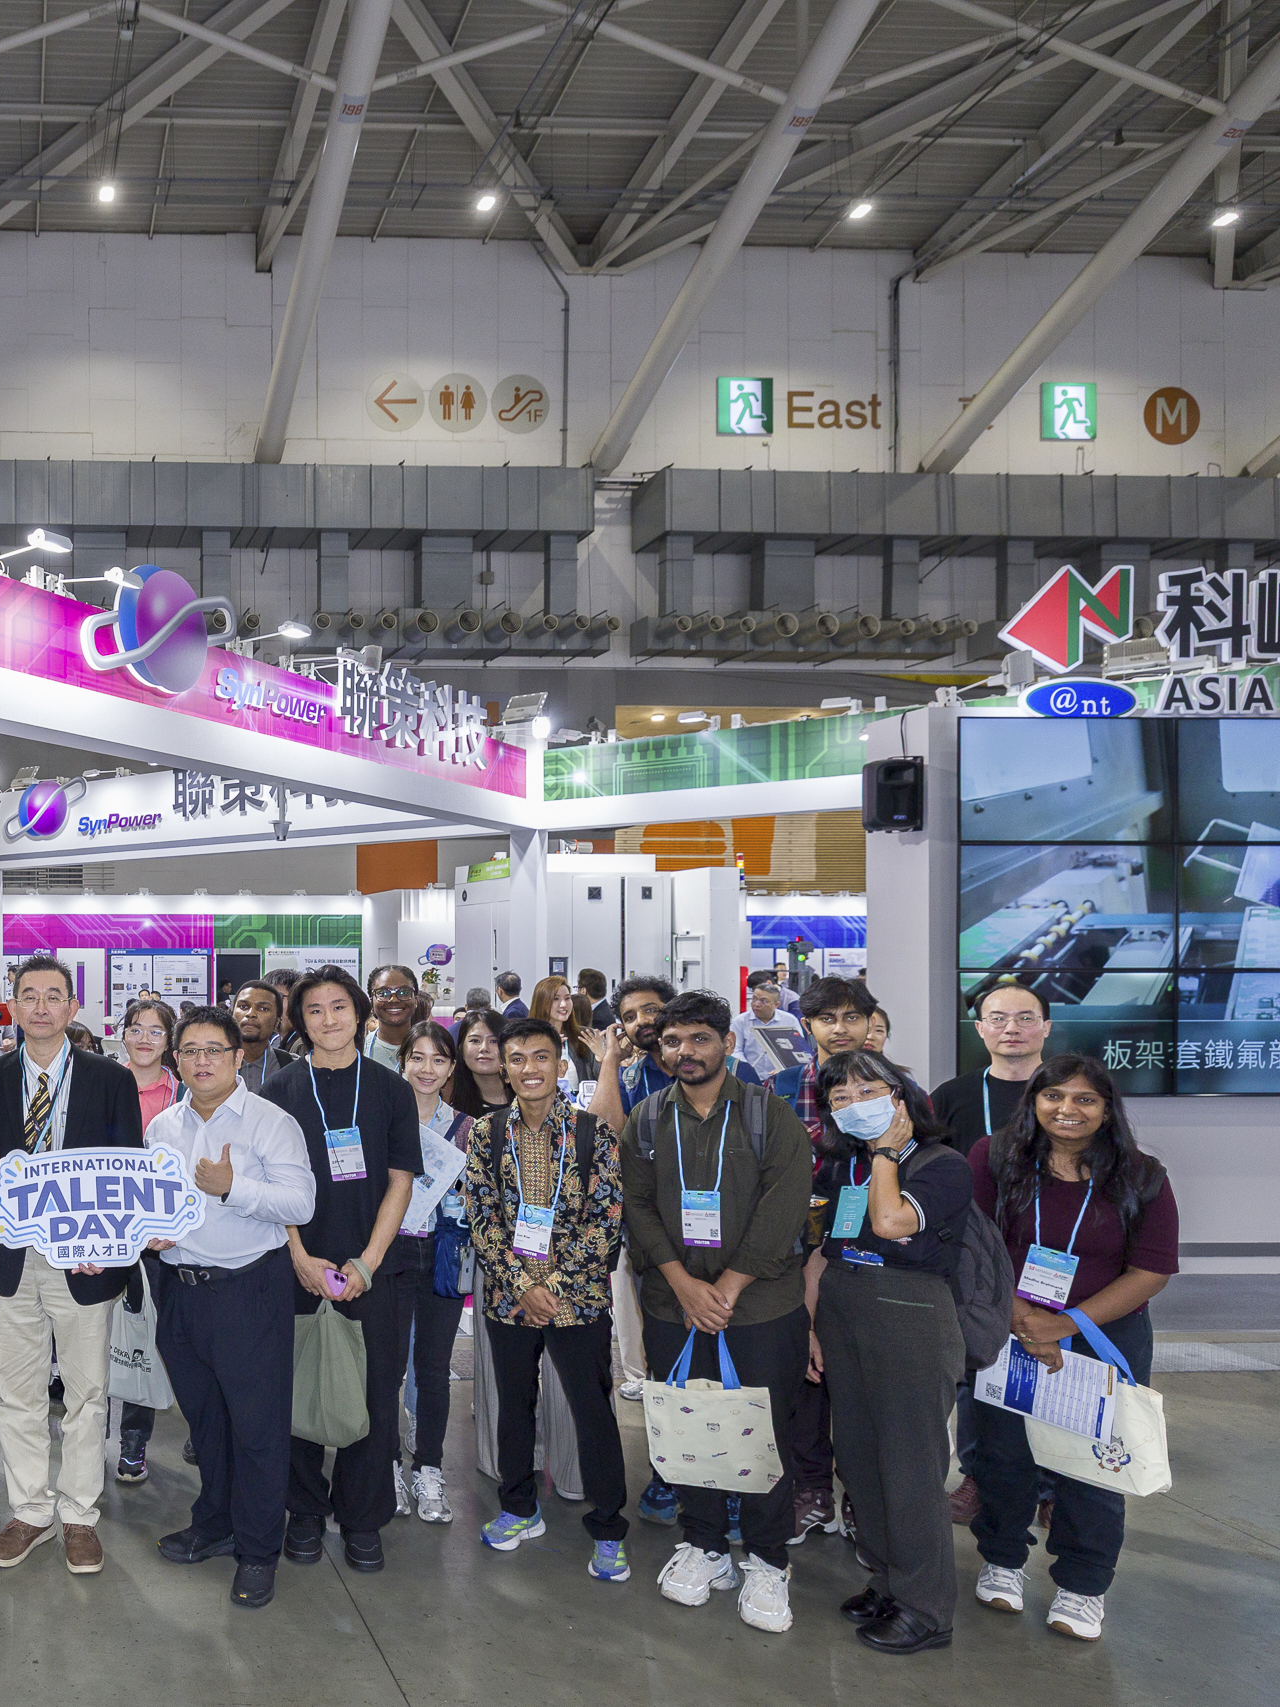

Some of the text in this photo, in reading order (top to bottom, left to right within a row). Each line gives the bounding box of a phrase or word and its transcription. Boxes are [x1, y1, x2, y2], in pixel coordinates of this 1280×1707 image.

[341, 103, 365, 116] 198
[526, 409, 544, 422] 1F
[787, 391, 883, 430] East
[1156, 396, 1188, 435] M
[217, 668, 327, 725] SynPower
[1162, 676, 1272, 712] ASIA
[338, 649, 489, 770] 聯策科技
[78, 813, 163, 836] SynPower
[24, 1158, 158, 1180] INTERNATIONAL
[8, 1176, 183, 1222] TALENT
[49, 1214, 135, 1243] DAY
[57, 1243, 129, 1259] 國際人才日
[1030, 1294, 1051, 1304] VISITOR
